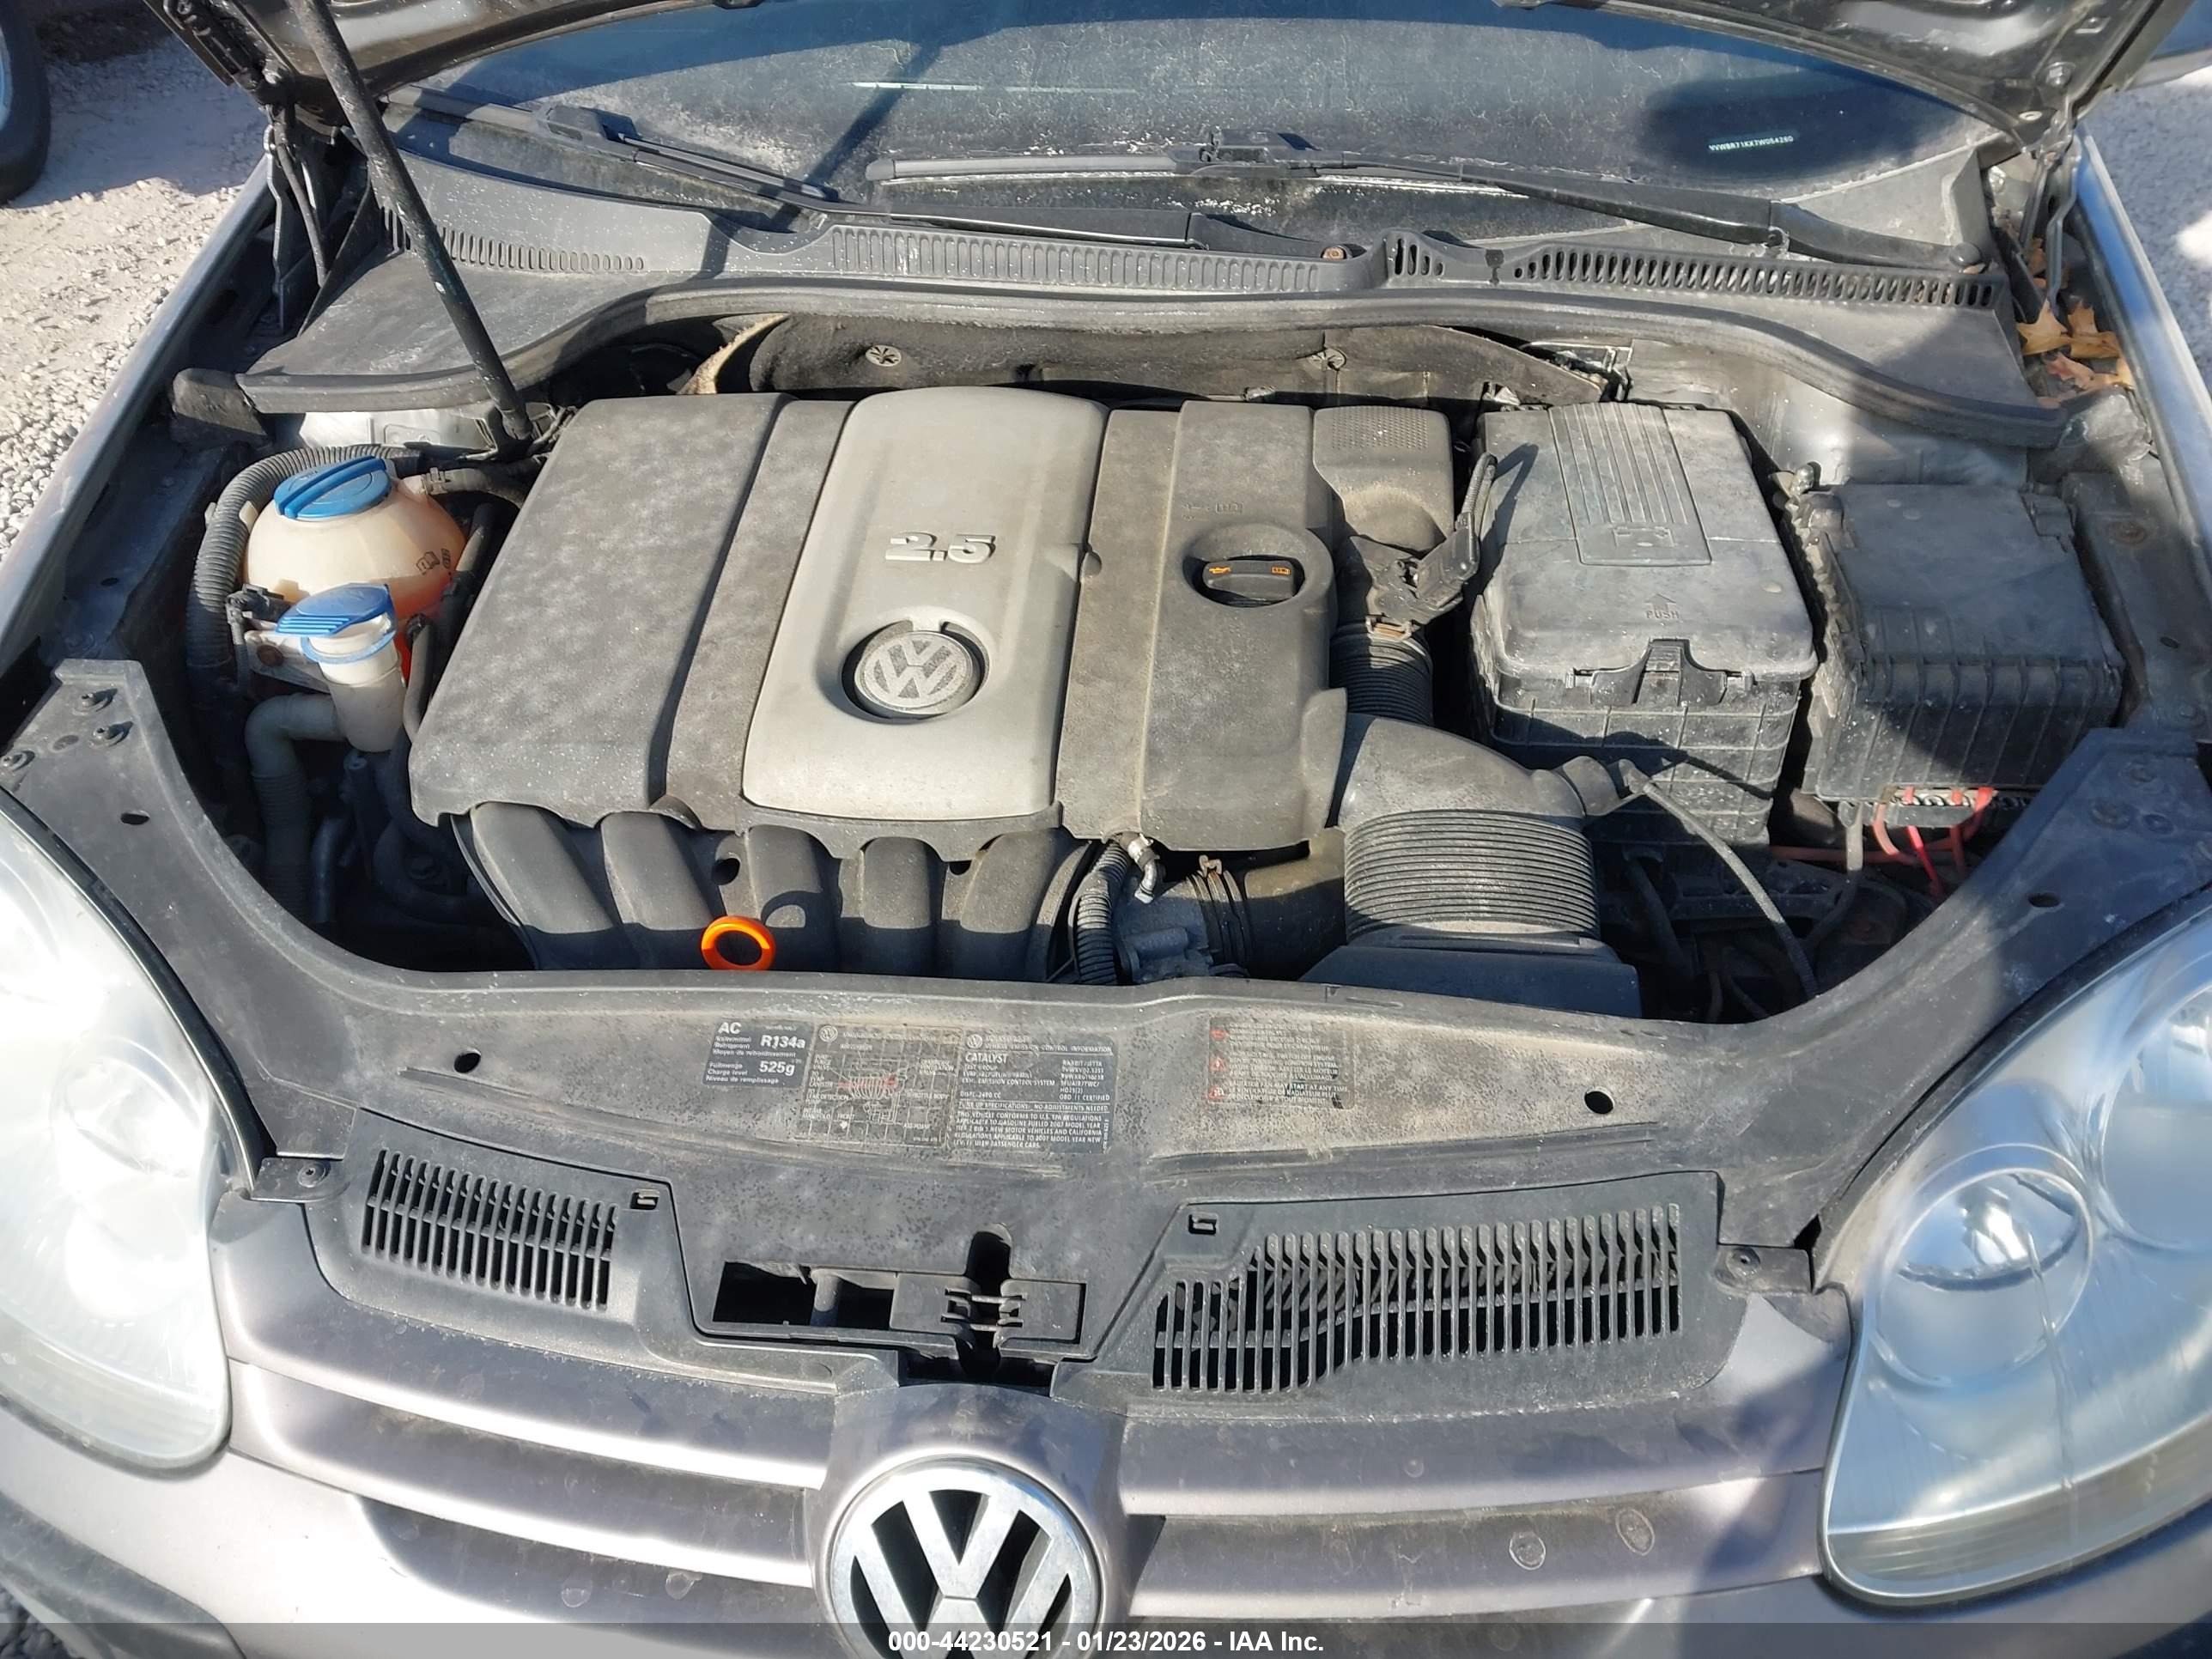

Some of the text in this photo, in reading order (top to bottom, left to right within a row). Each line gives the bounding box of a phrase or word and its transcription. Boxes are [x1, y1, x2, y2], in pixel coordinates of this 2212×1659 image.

[885, 532, 997, 564] 2.5
[1646, 611, 1680, 619] PUSH
[718, 1022, 743, 1034] AC
[761, 1035, 805, 1048] R134a
[964, 1052, 1008, 1064] CATALYST
[759, 1060, 796, 1077] 525g
